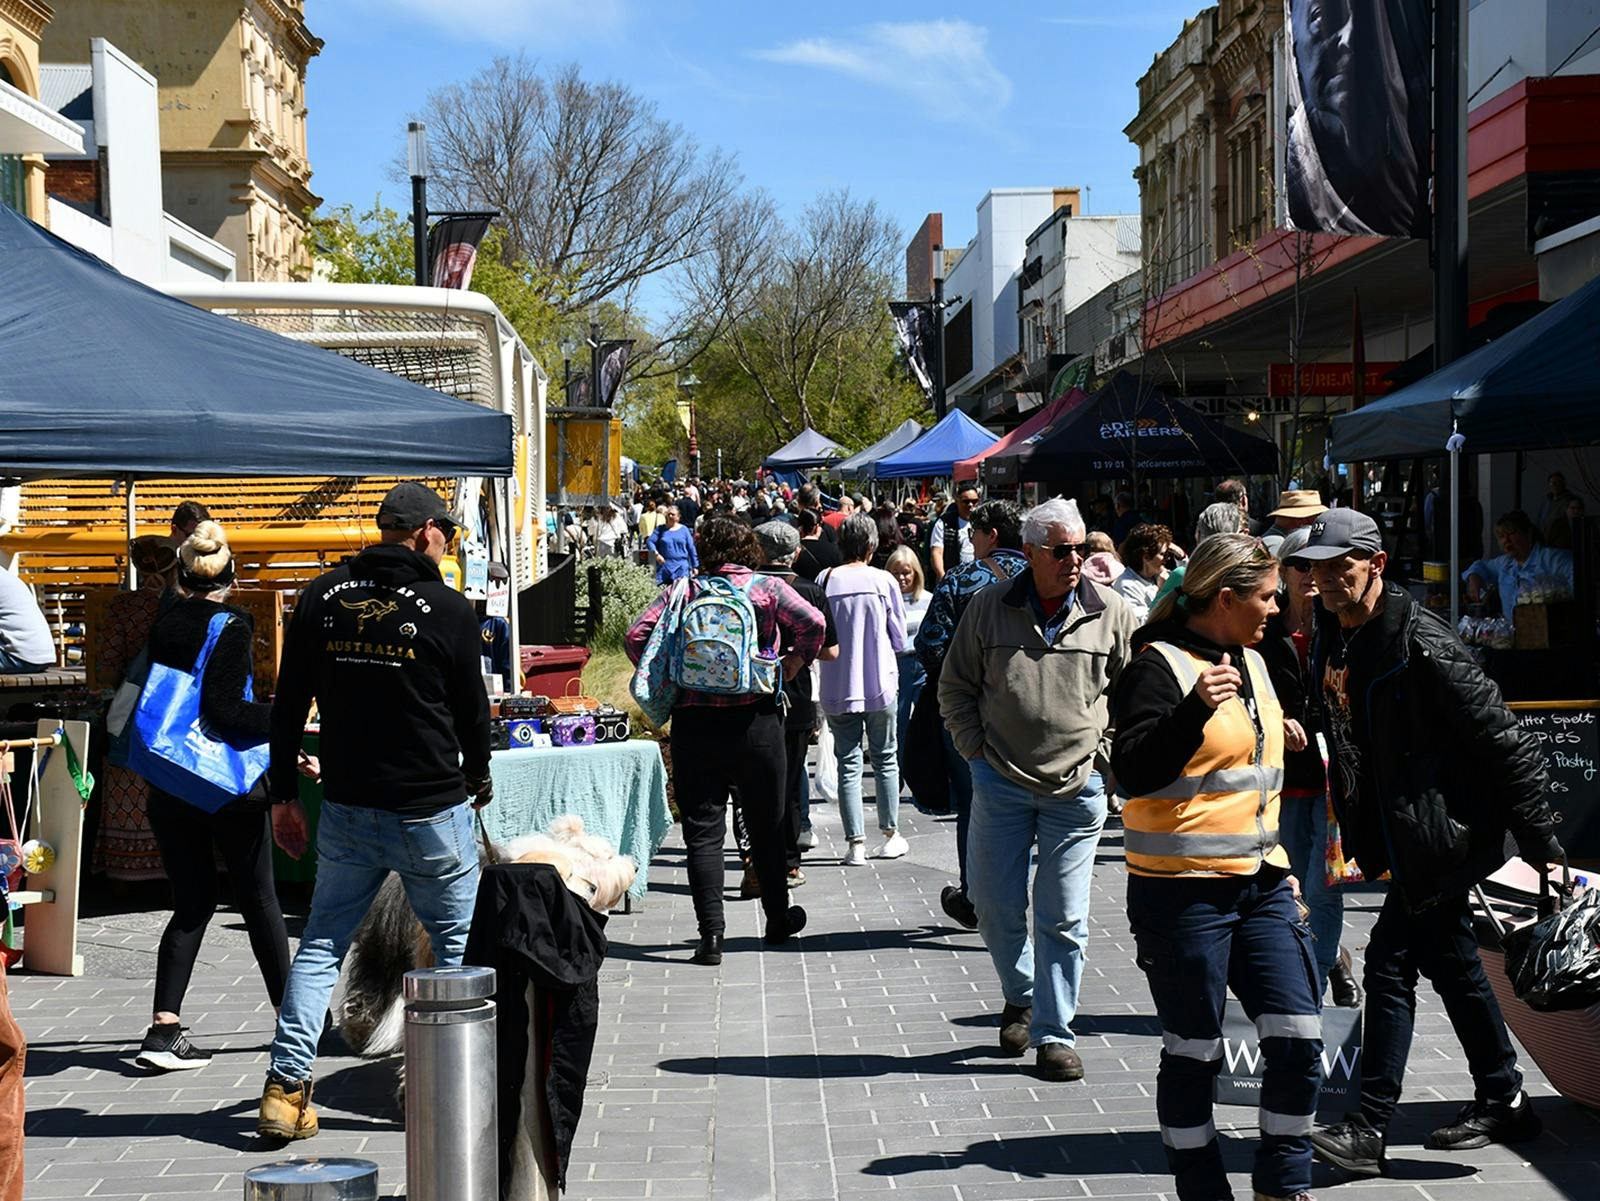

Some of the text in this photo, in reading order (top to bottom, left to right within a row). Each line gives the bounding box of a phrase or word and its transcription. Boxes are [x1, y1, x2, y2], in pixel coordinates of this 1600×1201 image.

[1315, 371, 1379, 387] REJT
[1100, 427, 1184, 440] CAREERS
[326, 640, 417, 660] AUSTRALIA
[1517, 714, 1546, 727] utter
[1552, 751, 1598, 781] Pastry
